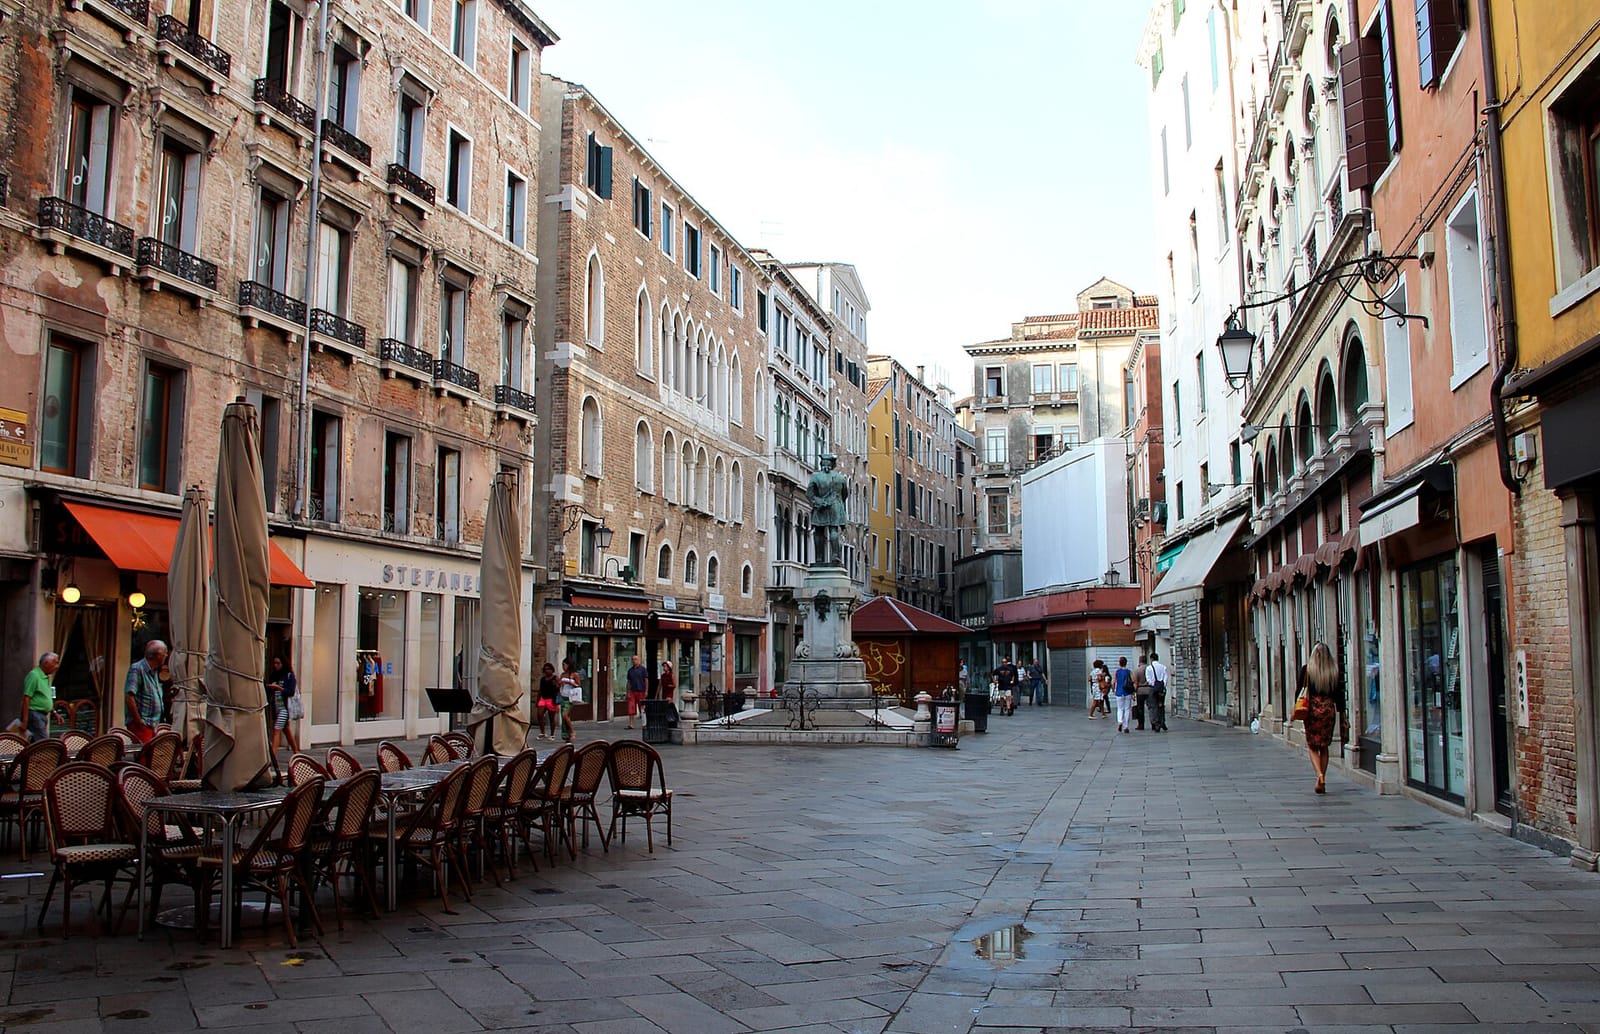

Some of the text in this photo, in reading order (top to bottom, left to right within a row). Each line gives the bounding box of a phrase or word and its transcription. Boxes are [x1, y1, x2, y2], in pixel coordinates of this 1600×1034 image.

[570, 615, 642, 630] FARMACIA MORELLI
[365, 661, 392, 675] SALE
